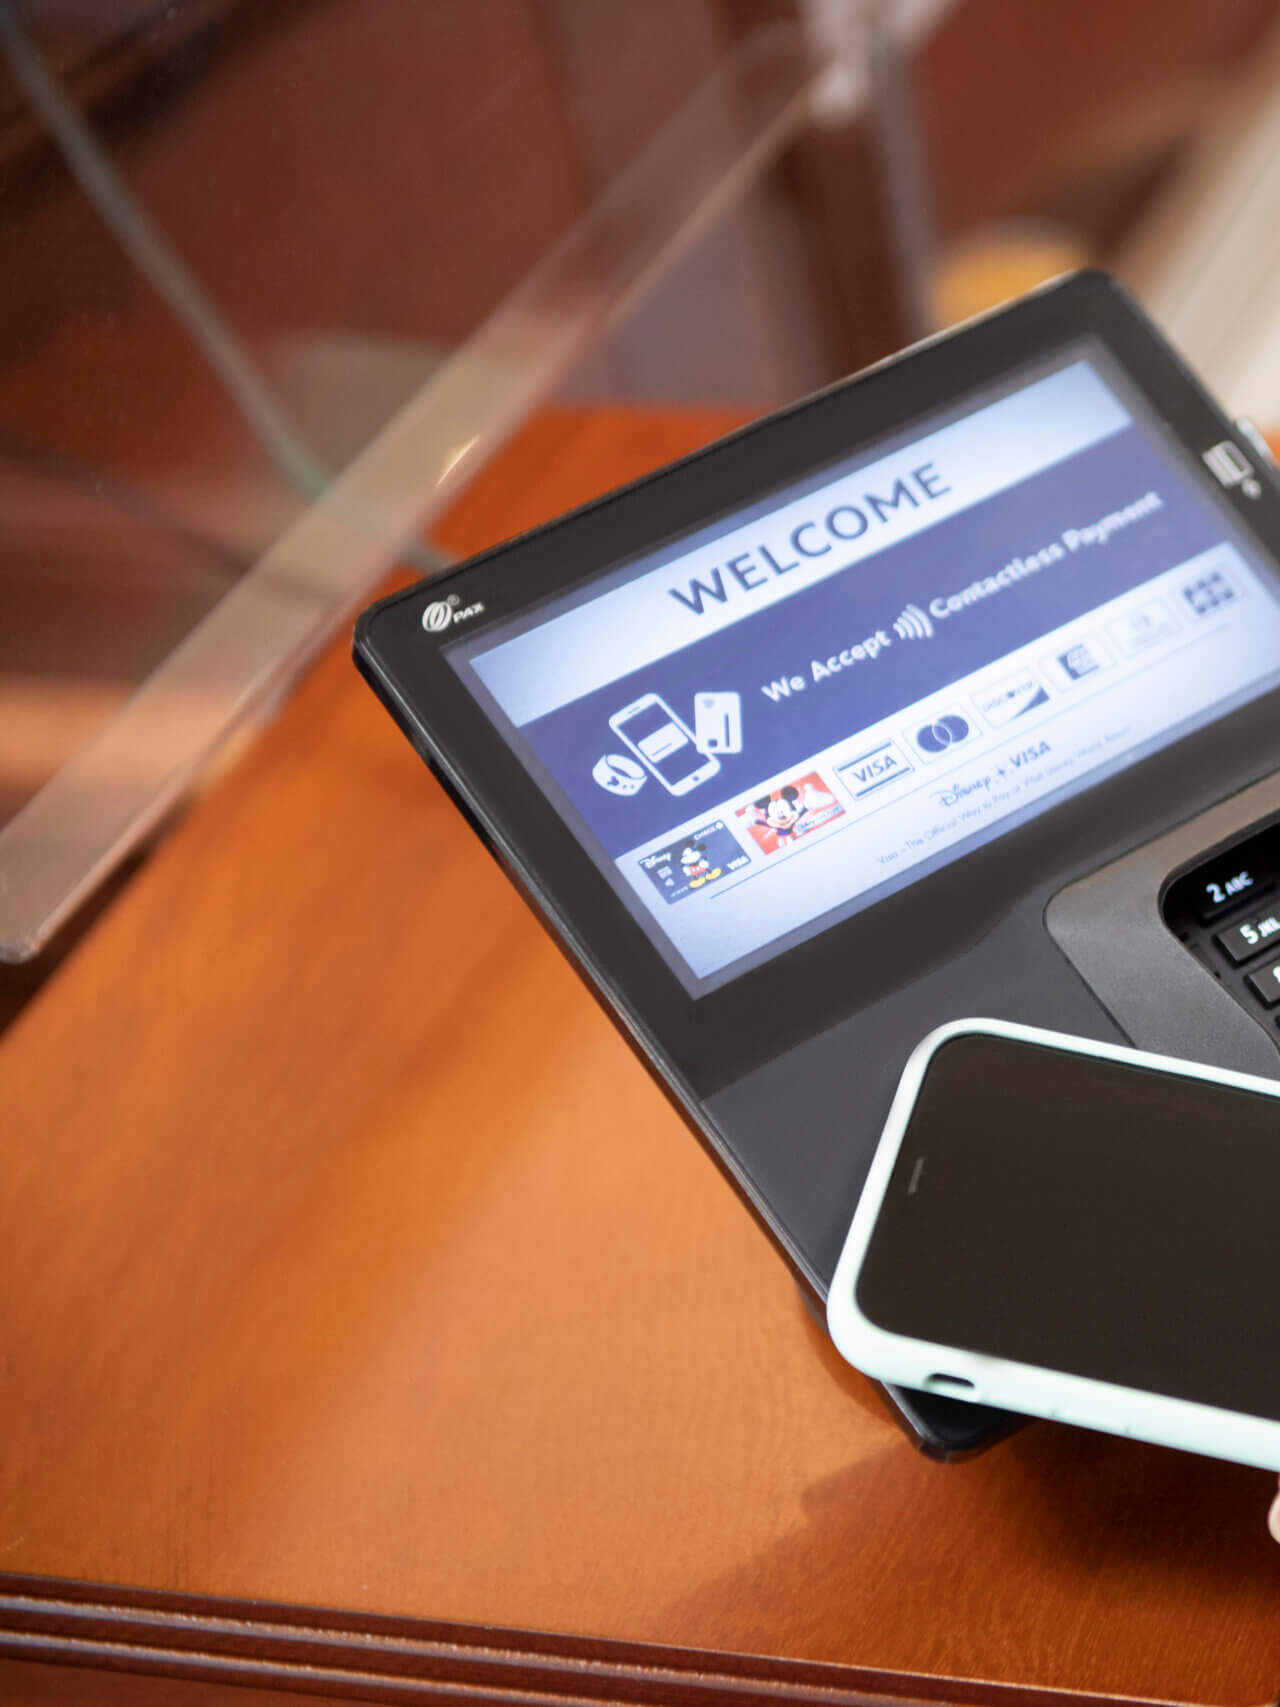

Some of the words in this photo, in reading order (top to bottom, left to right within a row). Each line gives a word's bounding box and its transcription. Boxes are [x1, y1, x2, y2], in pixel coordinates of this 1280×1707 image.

[667, 460, 952, 616] WELCOME
[761, 674, 806, 703] We
[810, 628, 892, 683] Accept
[928, 540, 1066, 619] Contactless
[1061, 490, 1165, 553] Payment
[452, 601, 485, 624] PAX
[853, 754, 898, 784] VISA
[929, 776, 993, 808] Disney
[1008, 740, 1052, 769] VISA
[727, 855, 750, 871] VISA
[1206, 883, 1226, 904] 2
[1225, 871, 1254, 896] ABC
[1240, 923, 1259, 945] 5
